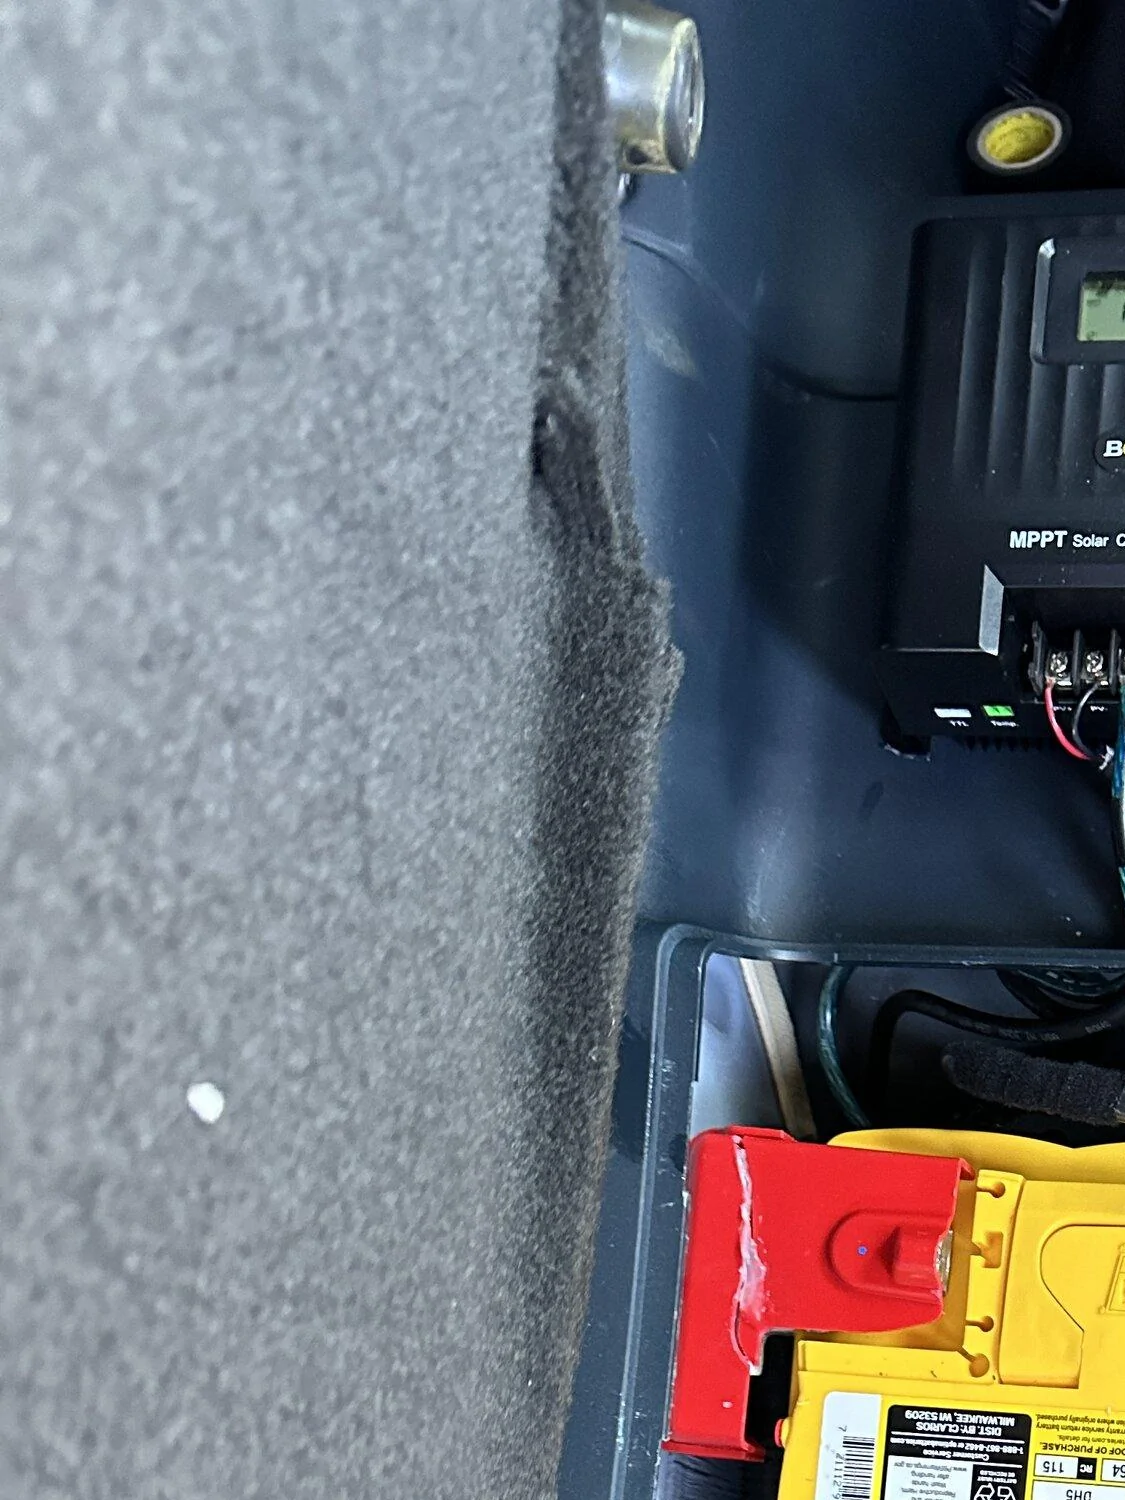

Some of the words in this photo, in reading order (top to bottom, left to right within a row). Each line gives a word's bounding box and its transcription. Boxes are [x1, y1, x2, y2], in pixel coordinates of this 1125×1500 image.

[1009, 530, 1067, 548] MPPT
[1072, 534, 1108, 548] Solar
[904, 1408, 937, 1421] 53209
[938, 1411, 952, 1421] WI
[953, 1411, 1014, 1426] MILWAUKEE,
[1068, 1414, 1095, 1424] originally
[915, 1420, 959, 1433] CLARIOS
[1035, 1421, 1059, 1430] battery
[1096, 1418, 1114, 1426] where
[959, 1424, 975, 1434] BY:
[976, 1424, 1001, 1436] DIST.
[1081, 1425, 1104, 1434] service
[1056, 1434, 1079, 1442] details.
[1039, 1441, 1092, 1453] PURCHASE.
[1095, 1446, 1106, 1454] OF
[922, 1448, 951, 1457] Service
[952, 1450, 989, 1460] Customer
[1042, 1460, 1064, 1473] 115
[1079, 1463, 1092, 1472] RC
